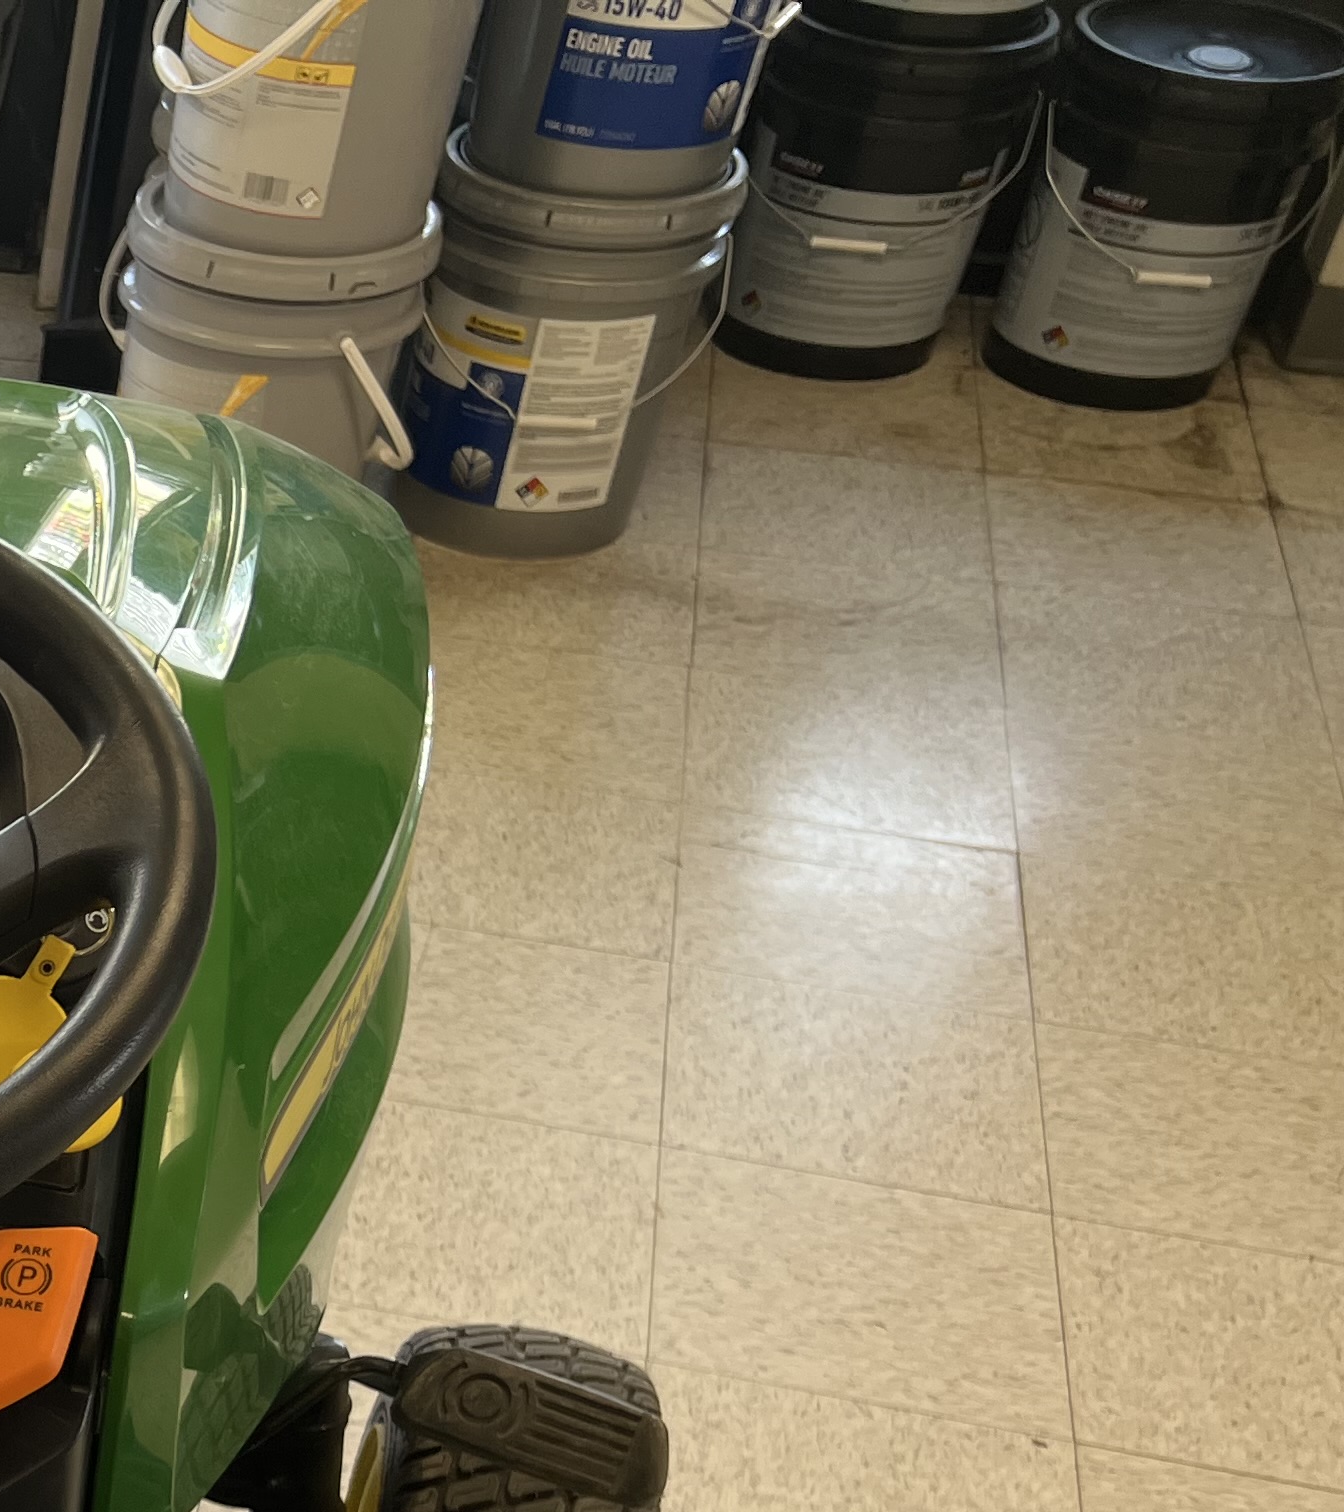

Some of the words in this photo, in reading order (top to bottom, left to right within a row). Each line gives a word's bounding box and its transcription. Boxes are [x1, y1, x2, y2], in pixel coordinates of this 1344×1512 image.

[565, 28, 625, 58] ENGINE
[627, 38, 654, 61] OIL
[560, 53, 605, 79] HUILE
[608, 62, 678, 85] MOTEUR
[13, 1244, 52, 1257] PARK
[17, 1266, 37, 1287] P
